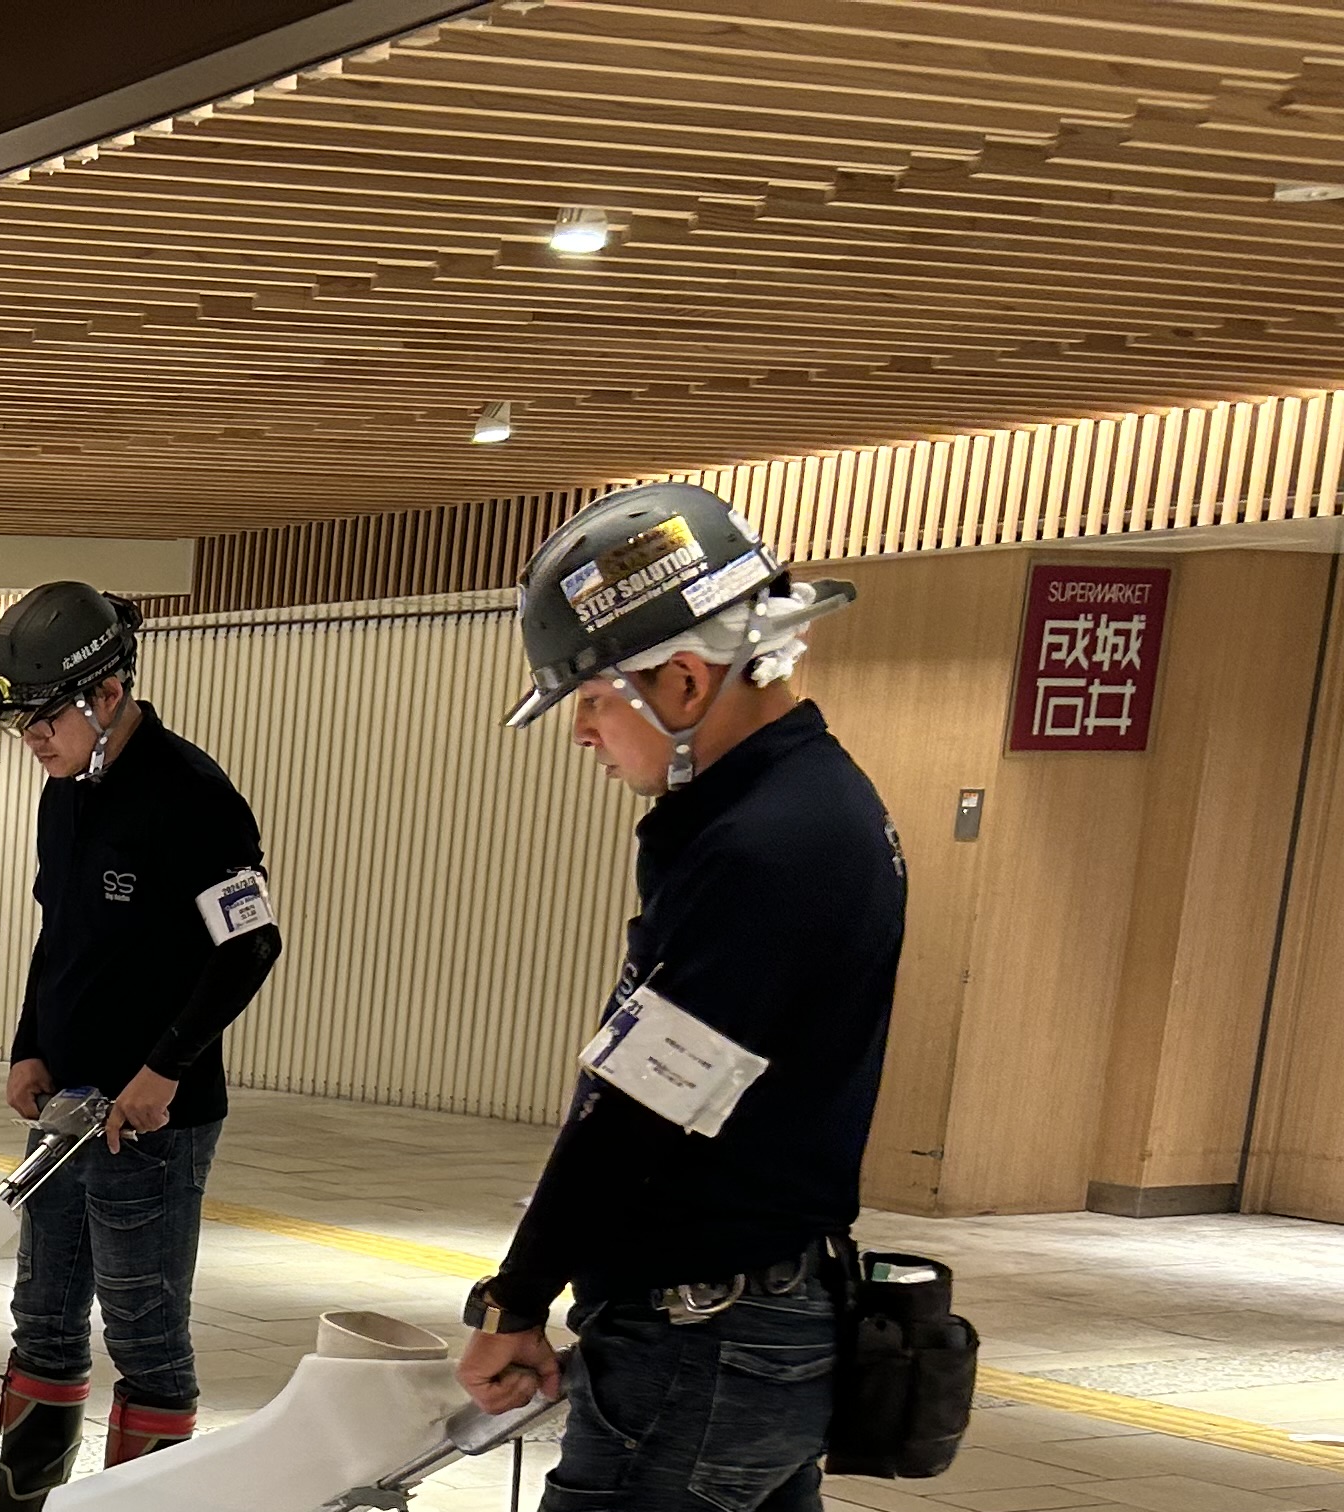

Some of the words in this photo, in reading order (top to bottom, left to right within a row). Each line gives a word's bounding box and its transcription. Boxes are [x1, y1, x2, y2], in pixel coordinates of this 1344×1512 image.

[575, 586, 617, 622] STEP
[617, 539, 705, 599] SOLUTION
[1047, 581, 1152, 605] SUPERMARKET
[1038, 613, 1146, 671] 成城
[1032, 678, 1137, 736] 石井
